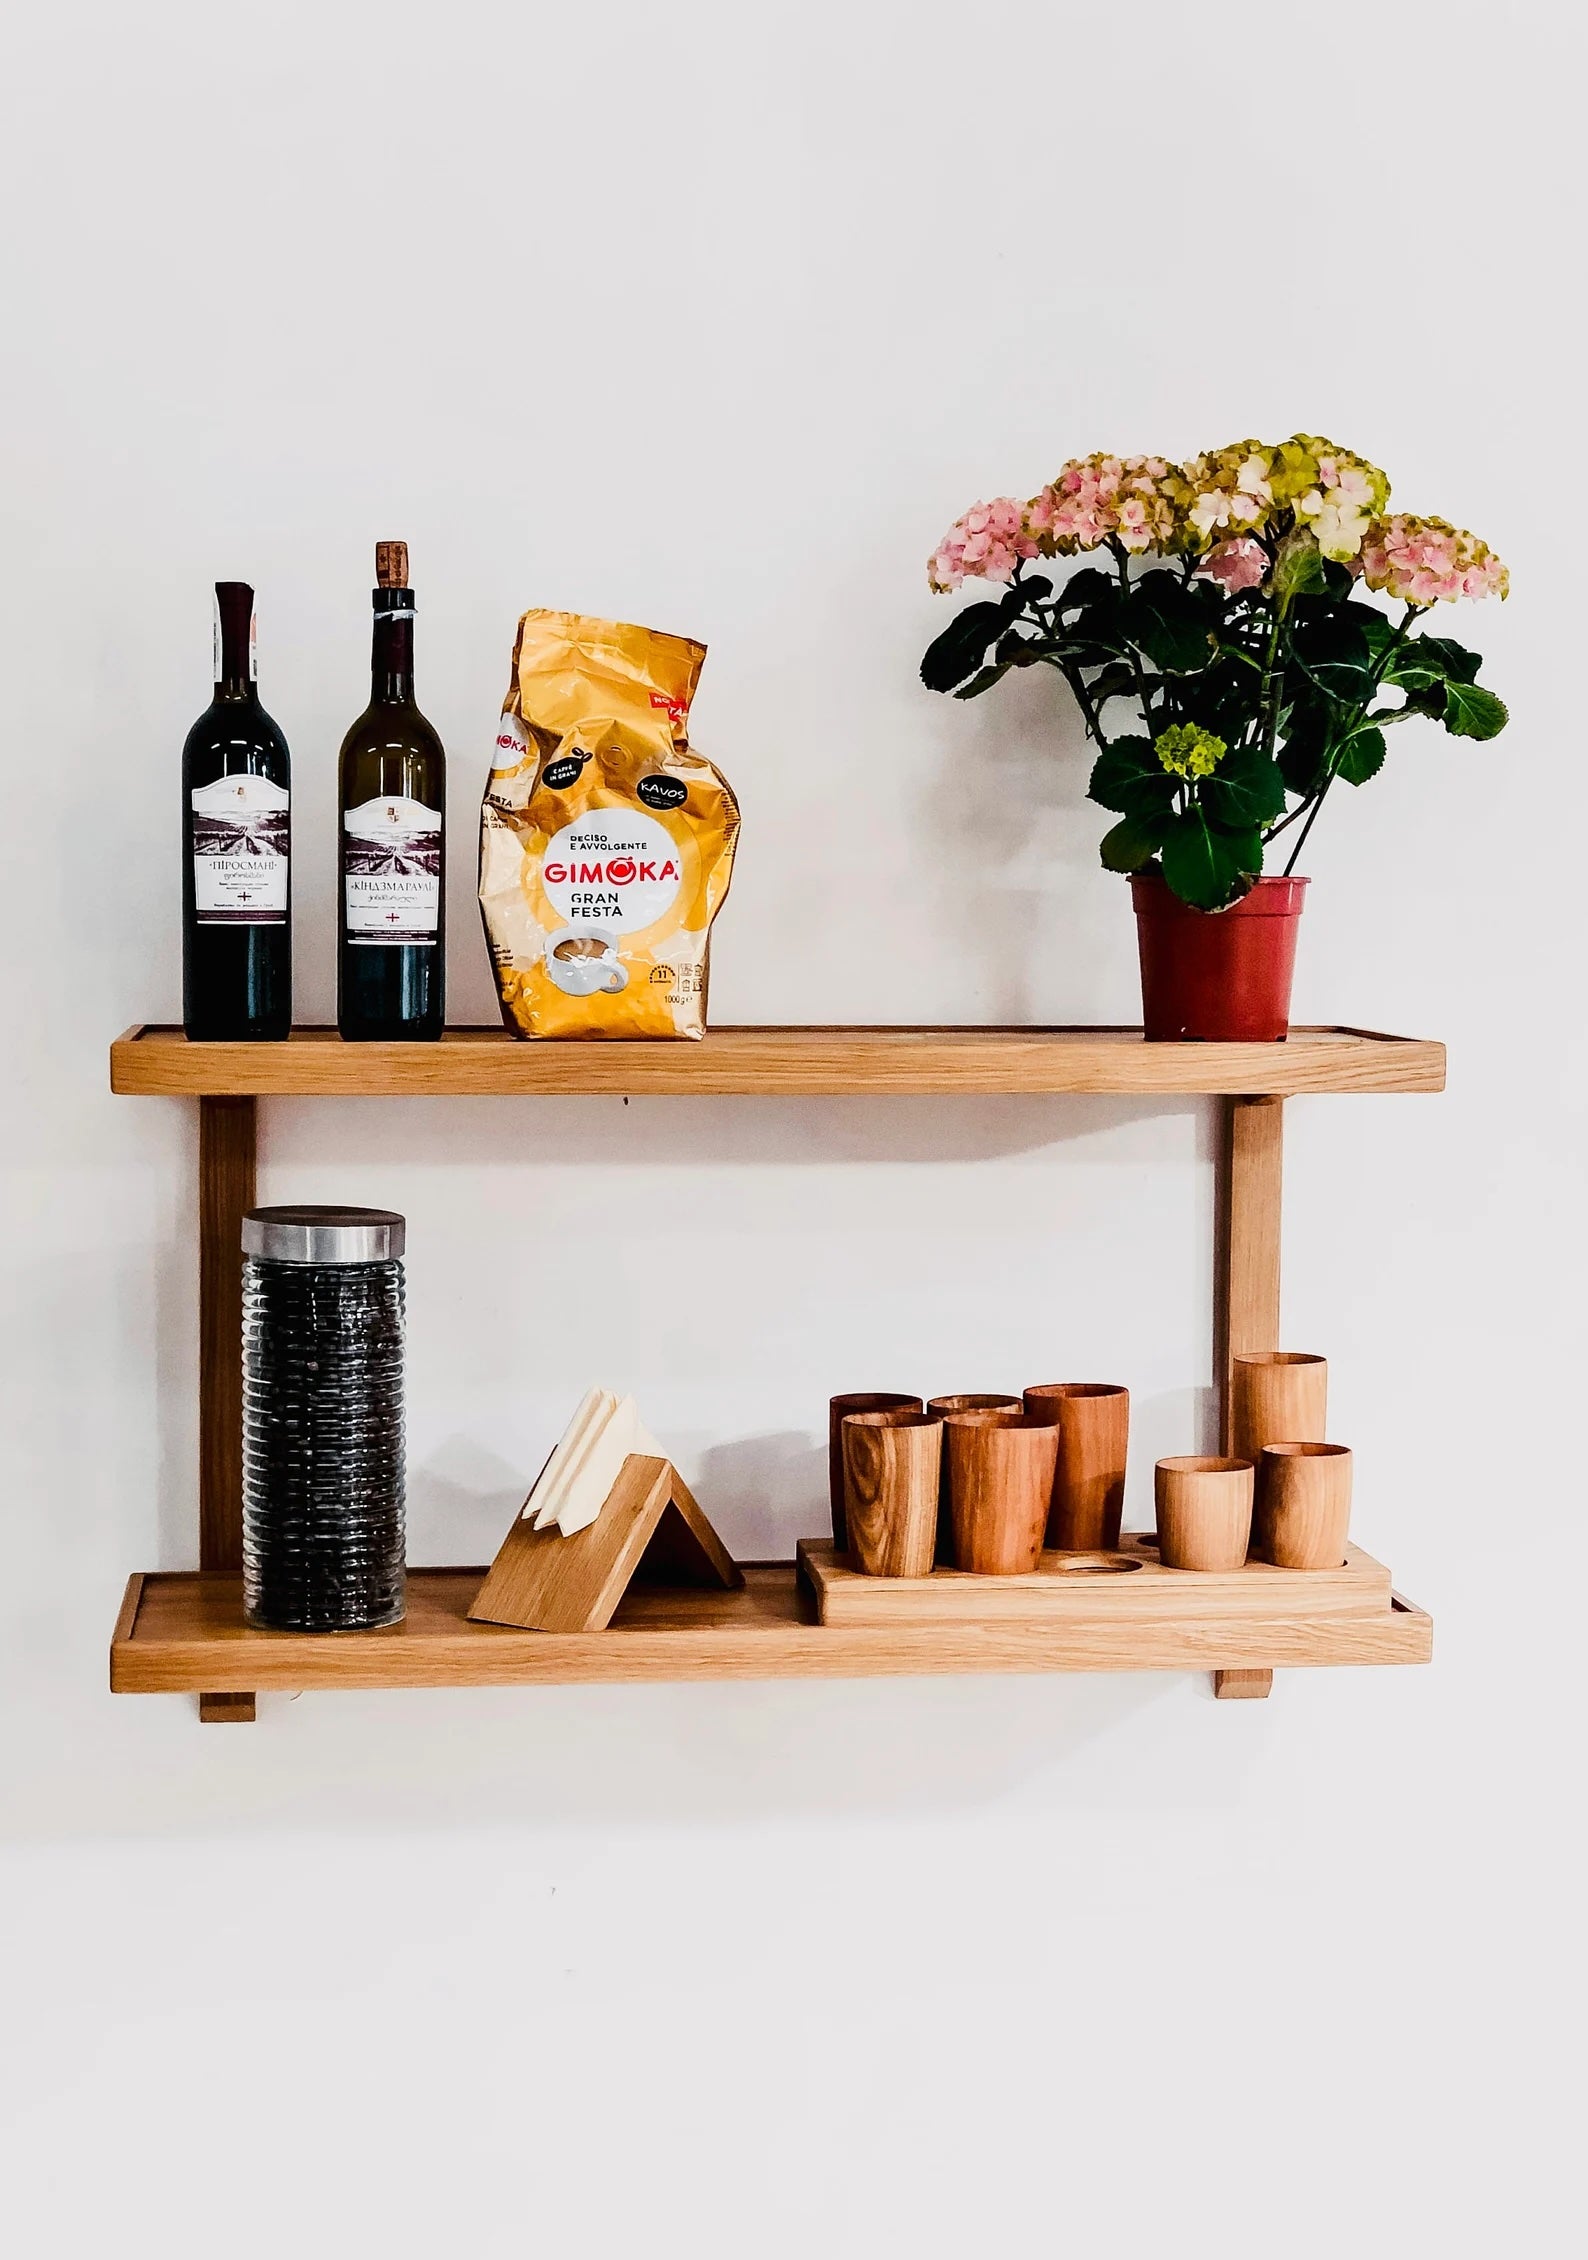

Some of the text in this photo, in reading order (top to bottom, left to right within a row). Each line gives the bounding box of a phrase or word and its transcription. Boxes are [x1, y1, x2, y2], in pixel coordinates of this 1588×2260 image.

[640, 782, 685, 800] KAVOS
[489, 792, 513, 808] ESTA
[570, 834, 608, 842] DECISO
[579, 842, 648, 851] AVVOLGENTE
[544, 856, 679, 886] GIMOKA
[571, 892, 619, 904] GRAN
[571, 906, 623, 917] FESTA
